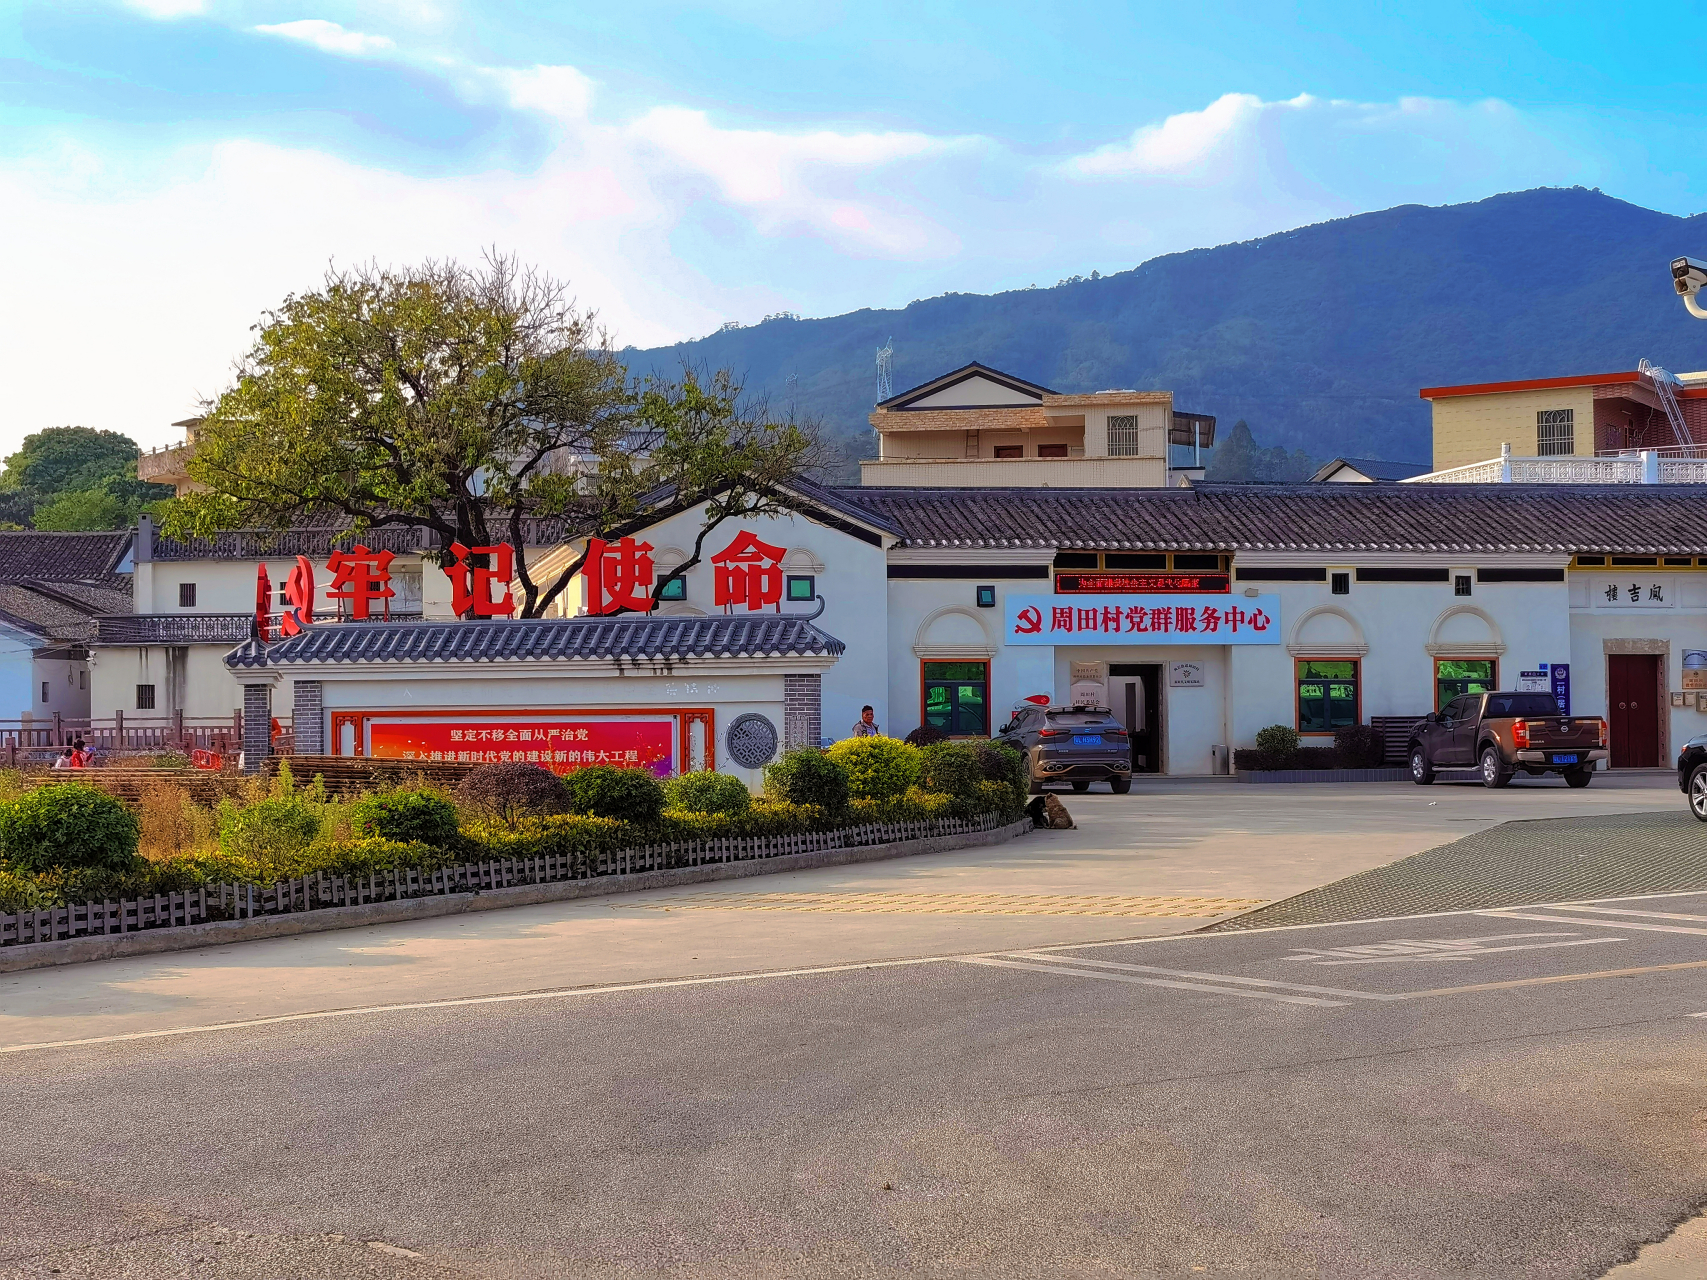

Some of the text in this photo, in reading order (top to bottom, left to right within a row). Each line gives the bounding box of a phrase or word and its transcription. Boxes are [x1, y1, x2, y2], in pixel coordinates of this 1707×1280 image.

[325, 529, 787, 620] 牢记使命
[1050, 605, 1271, 633] 周田村党群服务中心
[450, 728, 588, 742] 坚定不移全面从严治党
[402, 749, 638, 763] 深入推进新时代党的建设新的伟大工程
